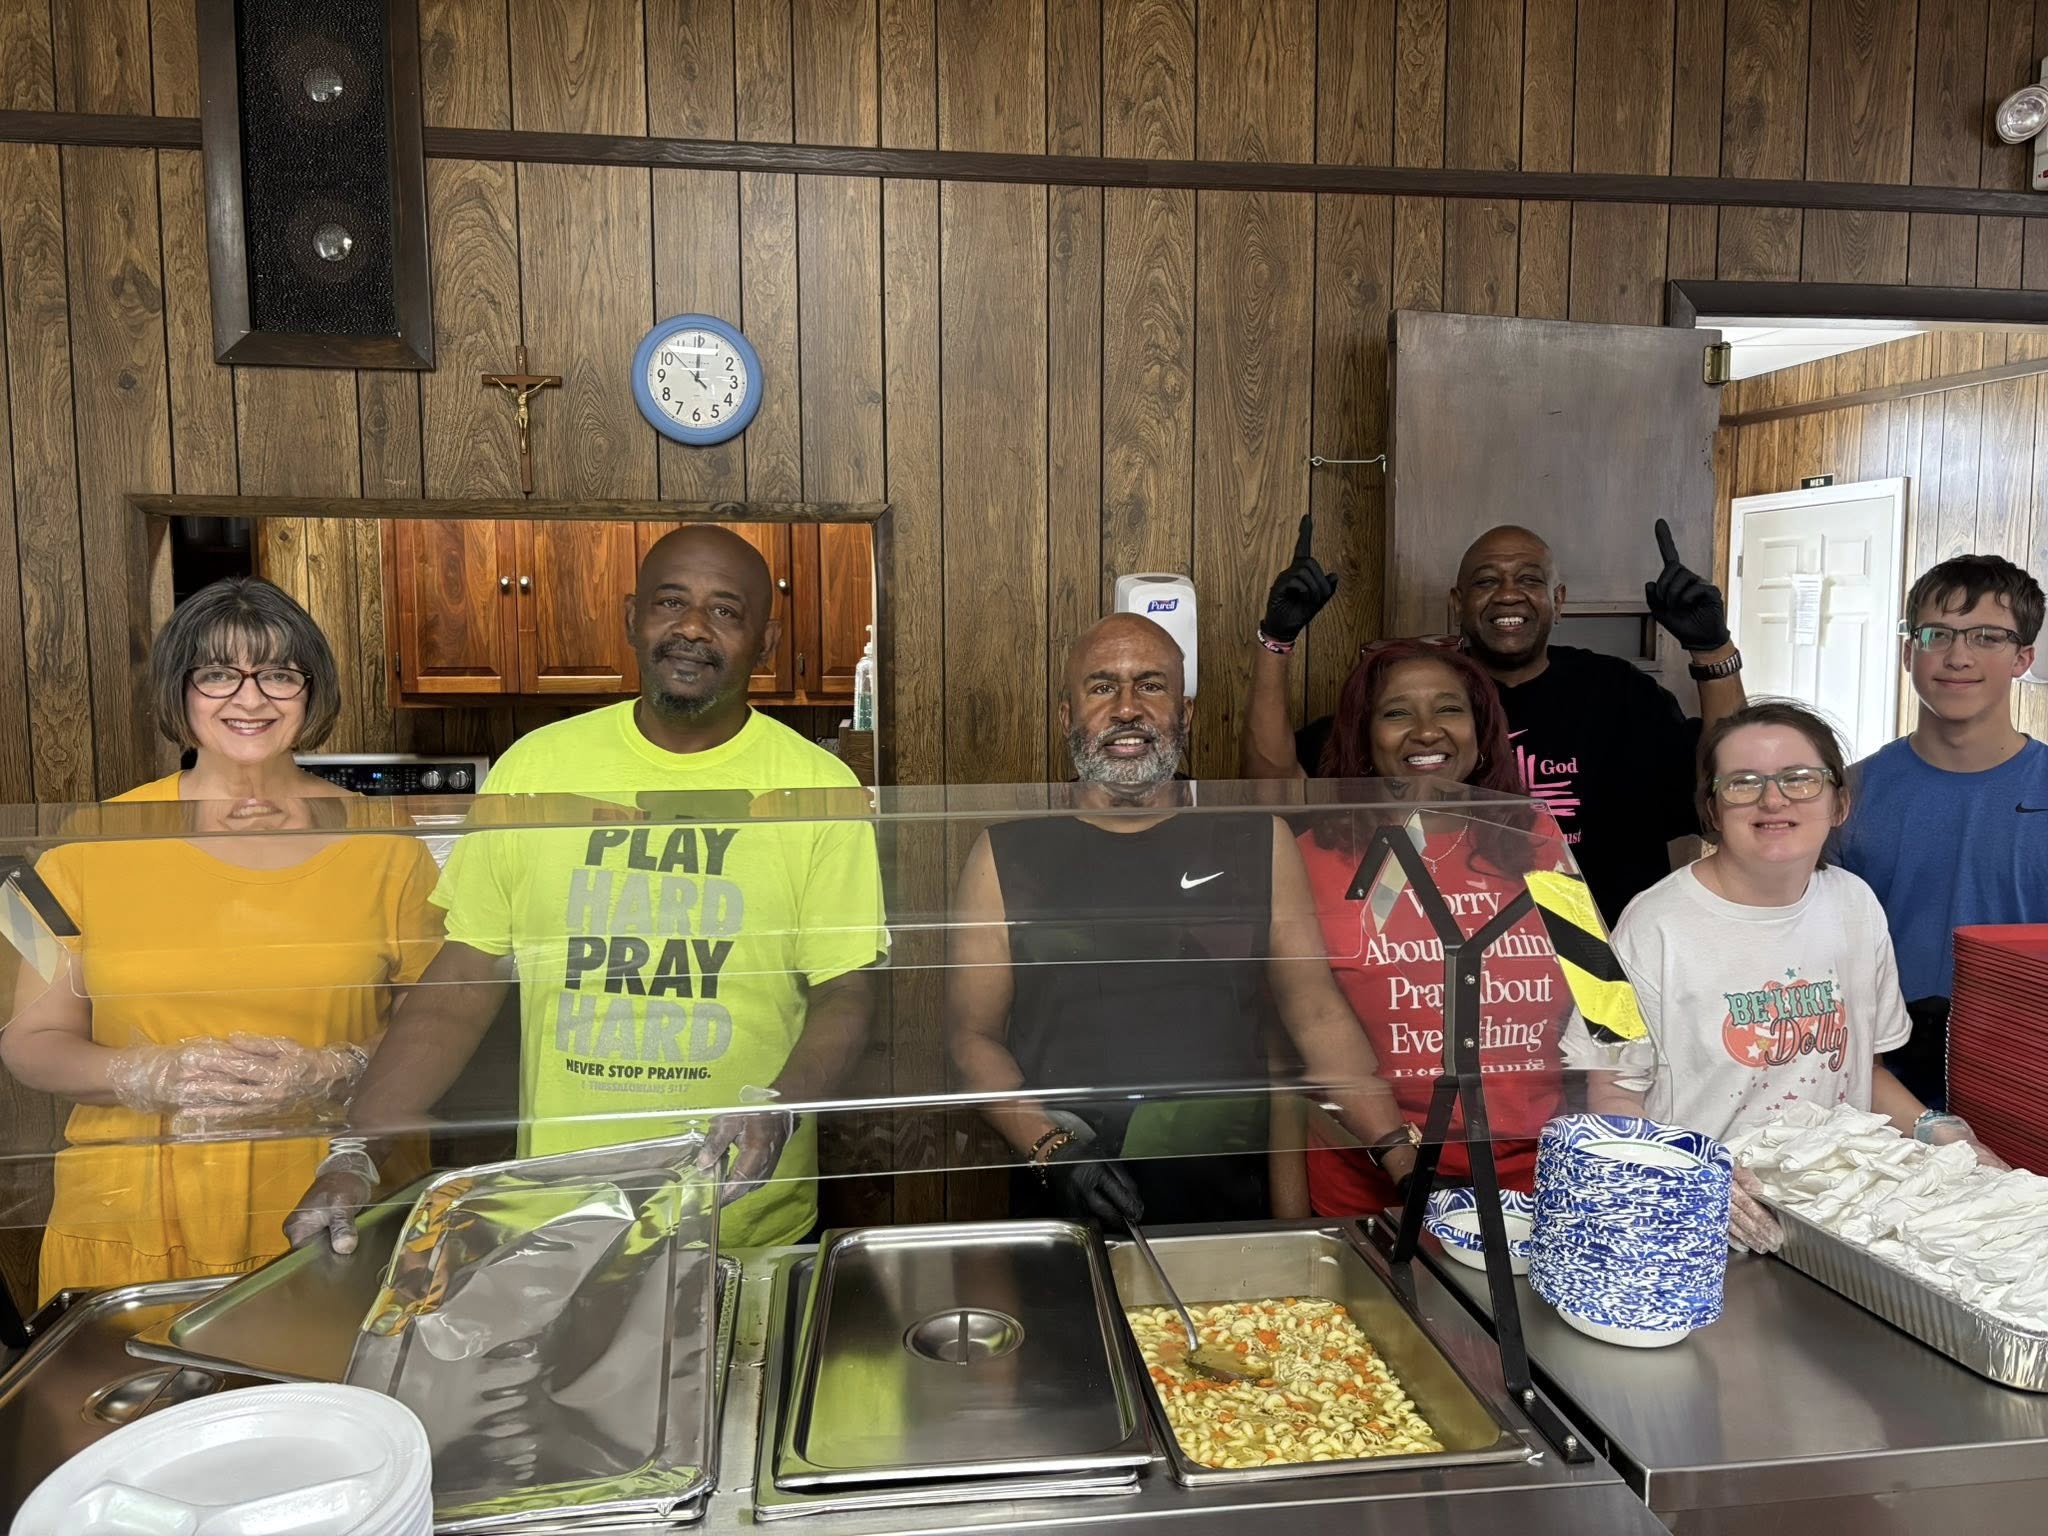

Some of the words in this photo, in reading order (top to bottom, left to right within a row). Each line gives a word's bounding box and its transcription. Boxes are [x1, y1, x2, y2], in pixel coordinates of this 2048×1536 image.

[661, 351, 673, 366] 10
[726, 357, 734, 371] 2
[657, 369, 666, 383] 9
[730, 375, 738, 389] 3
[662, 387, 670, 401] 8
[724, 393, 733, 407] 4
[675, 401, 683, 415] 7
[692, 408, 701, 421] 6
[711, 404, 719, 418] 5
[1151, 599, 1176, 610] Purell
[1540, 758, 1579, 774] God
[584, 828, 741, 876] PLAY
[565, 868, 745, 937] HARD
[1363, 933, 1444, 966] About
[564, 936, 735, 999] PRAY
[1387, 976, 1444, 1015] Pra
[1480, 970, 1553, 1006] bout
[1727, 990, 1770, 1026] BE
[1772, 980, 1837, 1020] LIKE
[555, 990, 733, 1063] HARD
[1388, 1015, 1548, 1054] Evething
[1765, 1012, 1848, 1072] Dolly
[566, 1058, 604, 1077] NEVER
[608, 1065, 643, 1079] STOP
[647, 1066, 712, 1080] PRAYING.
